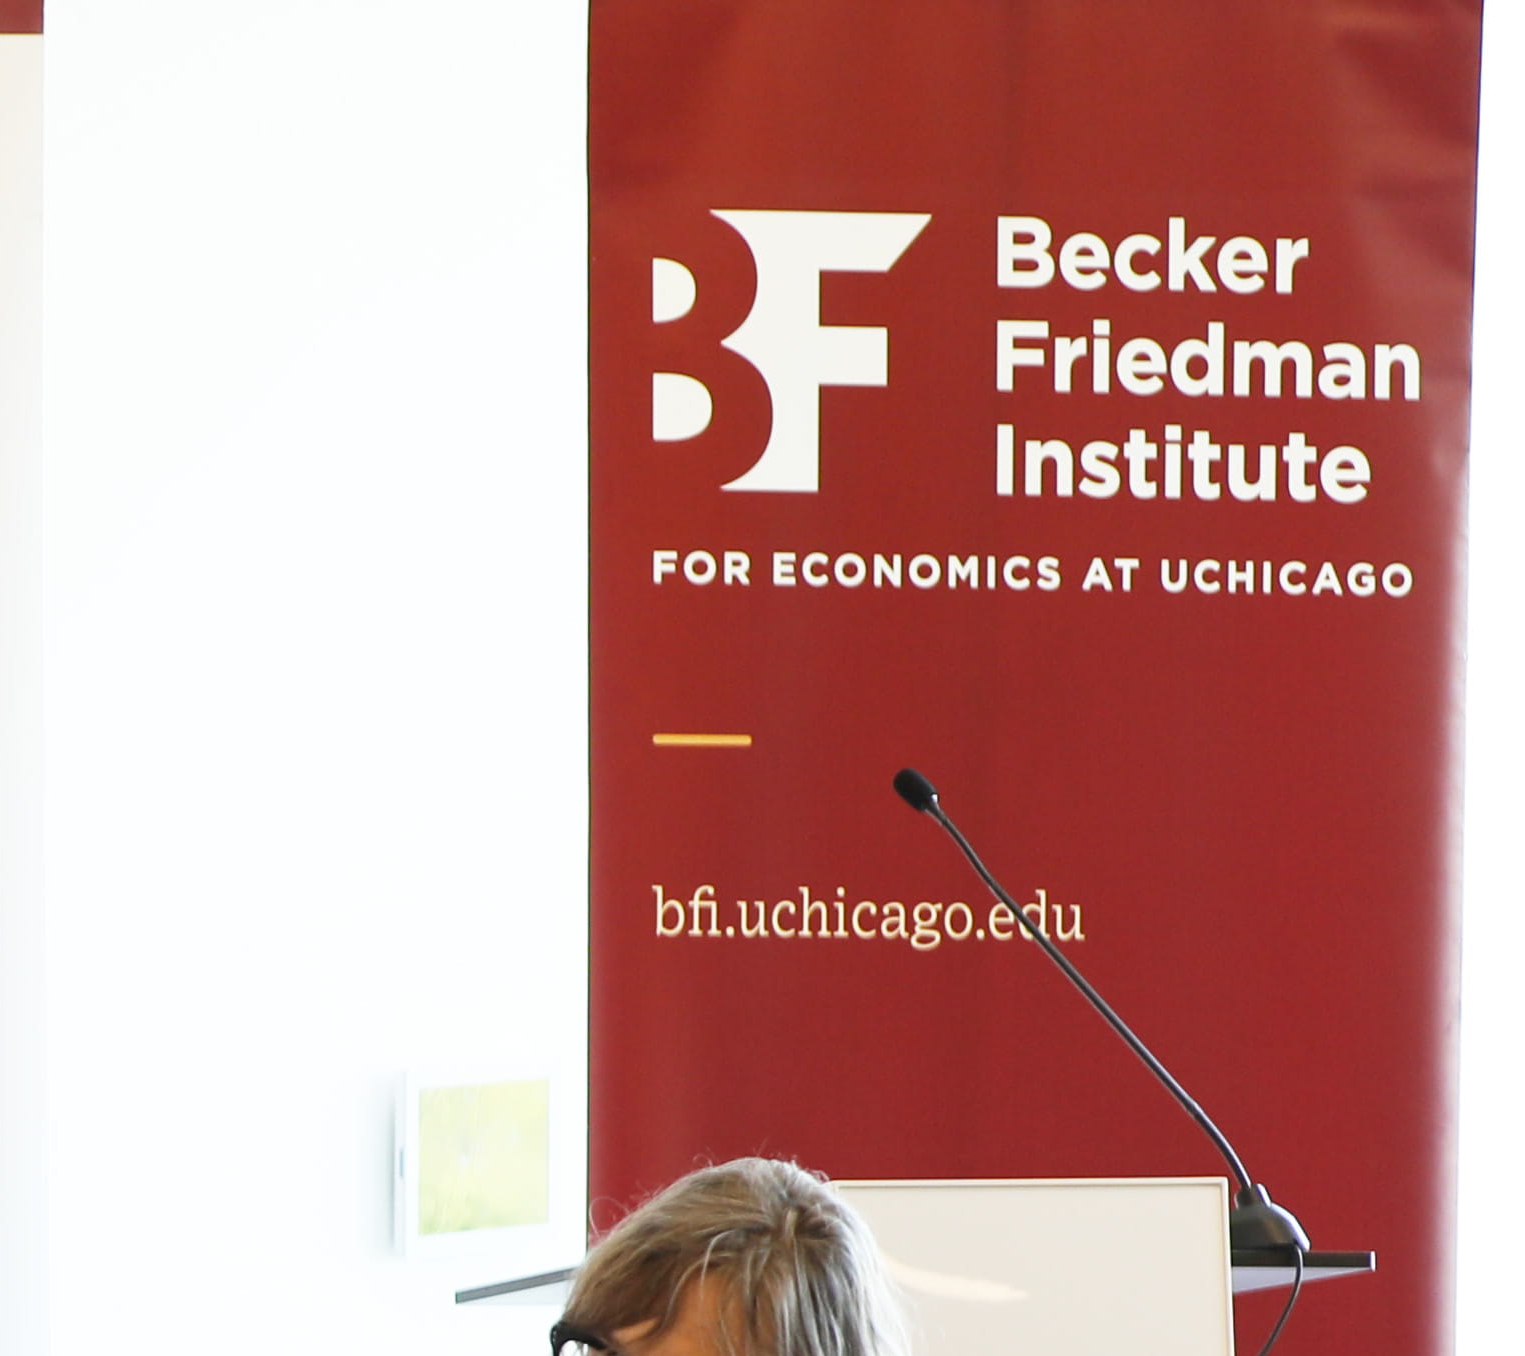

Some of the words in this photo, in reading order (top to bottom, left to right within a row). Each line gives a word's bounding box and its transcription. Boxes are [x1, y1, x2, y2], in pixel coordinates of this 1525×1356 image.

[996, 215, 1310, 294] Becker
[996, 318, 1421, 402] Friedman
[996, 423, 1371, 504] Institute
[652, 550, 751, 586] FOR
[772, 551, 1061, 591] ECONOMICS
[1082, 557, 1140, 592] AT
[1160, 558, 1413, 598] UCHICAGO
[651, 884, 1086, 952] bfi.uchicago.edu
